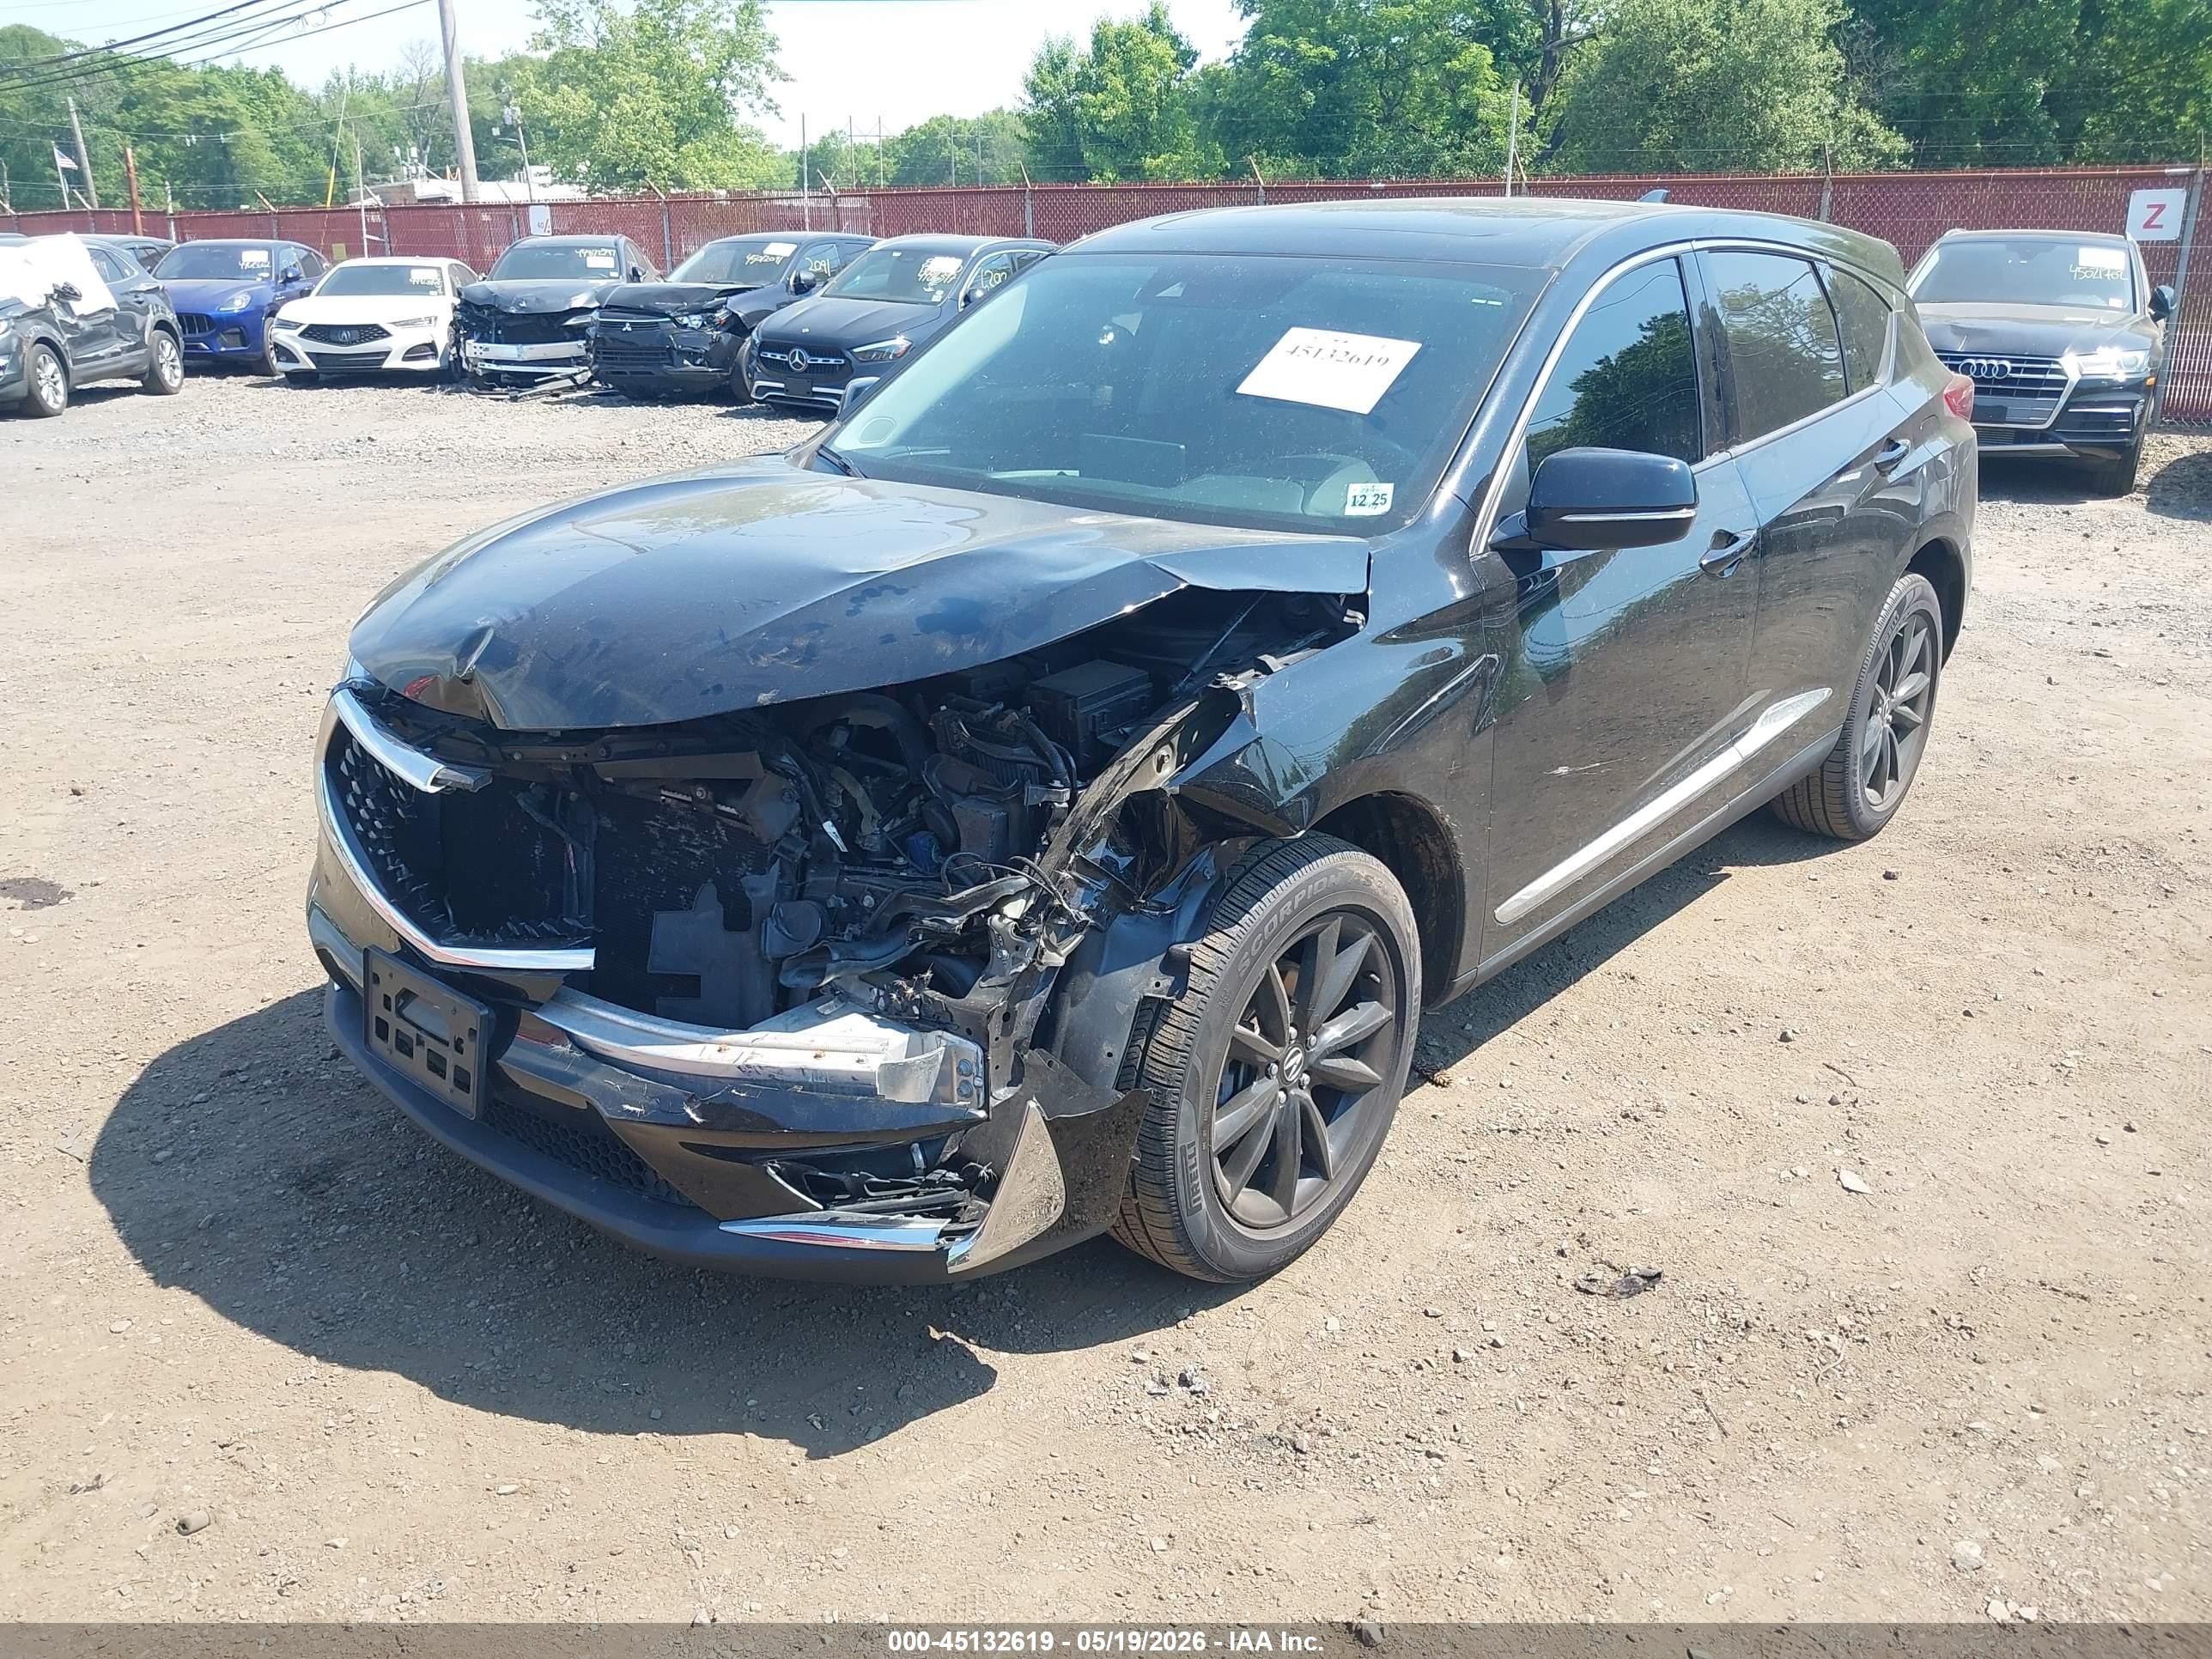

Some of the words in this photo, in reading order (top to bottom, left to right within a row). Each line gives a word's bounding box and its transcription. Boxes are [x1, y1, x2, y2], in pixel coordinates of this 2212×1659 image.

[2142, 204, 2166, 229] Z
[805, 258, 831, 277] 2091
[1351, 494, 1367, 507] 12
[1371, 493, 1388, 506] 25
[1237, 870, 1341, 977] SCORPION
[1180, 1140, 1204, 1218] PIRELLI
